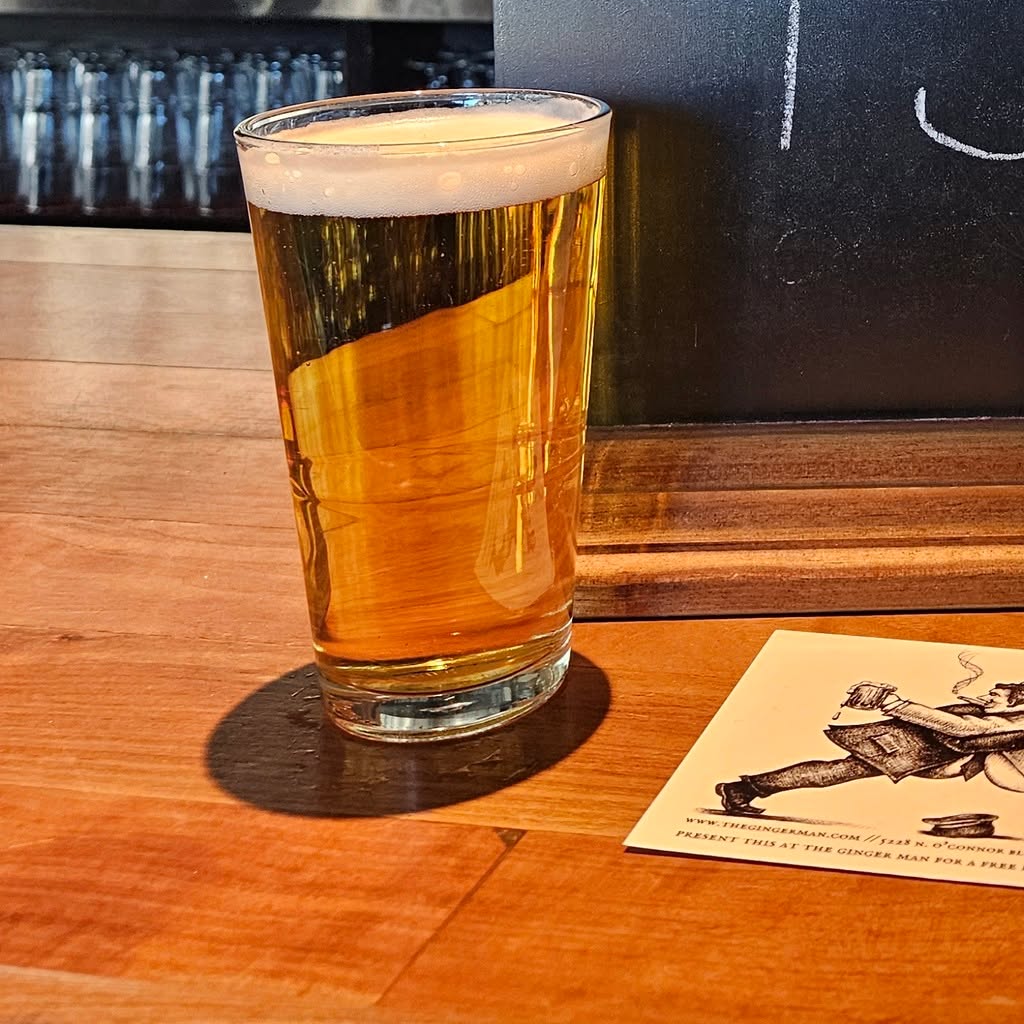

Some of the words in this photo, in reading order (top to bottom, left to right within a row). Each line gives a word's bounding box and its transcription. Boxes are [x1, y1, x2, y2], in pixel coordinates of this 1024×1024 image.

[675, 830, 741, 843] PRESENT
[743, 838, 777, 848] THIS
[779, 841, 801, 849] AT
[804, 844, 833, 853] THE
[837, 847, 893, 859] GINGER
[896, 853, 931, 862] MAN
[934, 856, 967, 866] FOR
[979, 860, 1017, 871] FREE
[932, 840, 1005, 855] O'CONNOR
